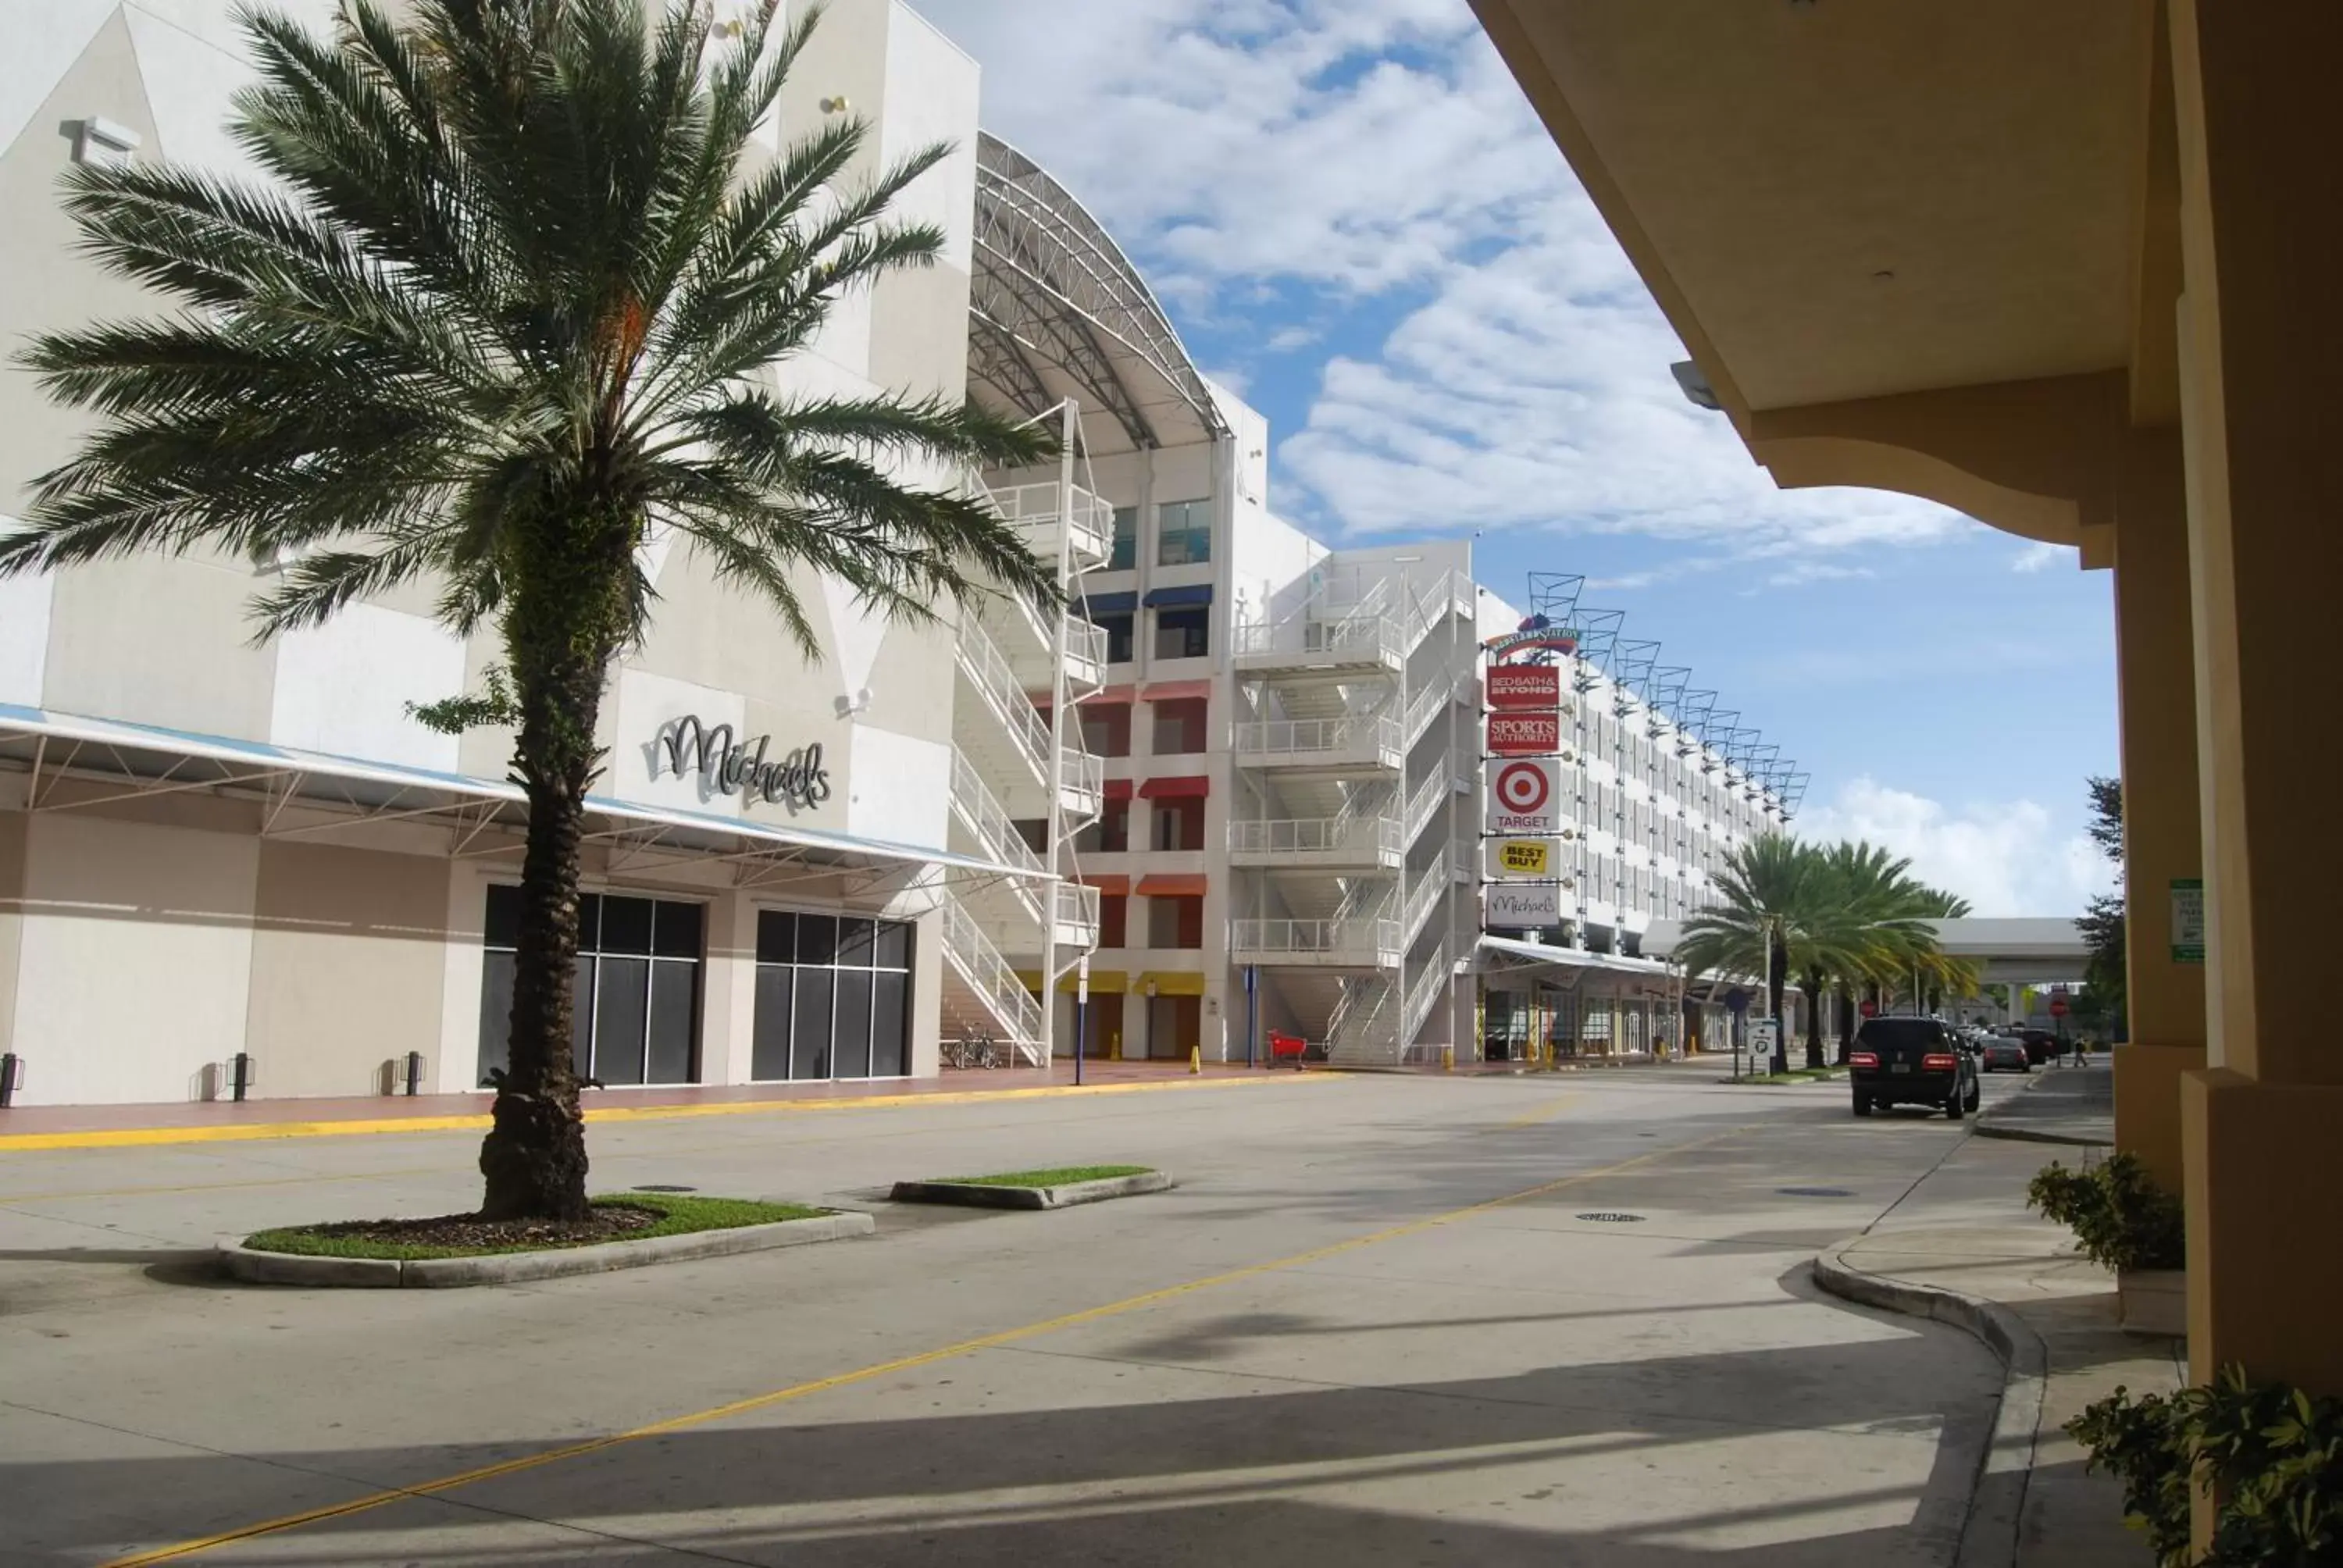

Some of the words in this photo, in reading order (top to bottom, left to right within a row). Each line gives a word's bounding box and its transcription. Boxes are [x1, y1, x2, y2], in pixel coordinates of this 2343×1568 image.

[1491, 677, 1513, 686] BED
[1514, 677, 1545, 686] BATH
[1546, 676, 1555, 686] &
[1491, 721, 1556, 735] SPORTS
[1492, 734, 1556, 743] AUTHORITY
[664, 715, 832, 810] Michaels
[1497, 816, 1550, 828] TARGET
[1506, 846, 1544, 858] BEST
[1507, 856, 1541, 868] BUY
[1492, 895, 1555, 915] Michaels
